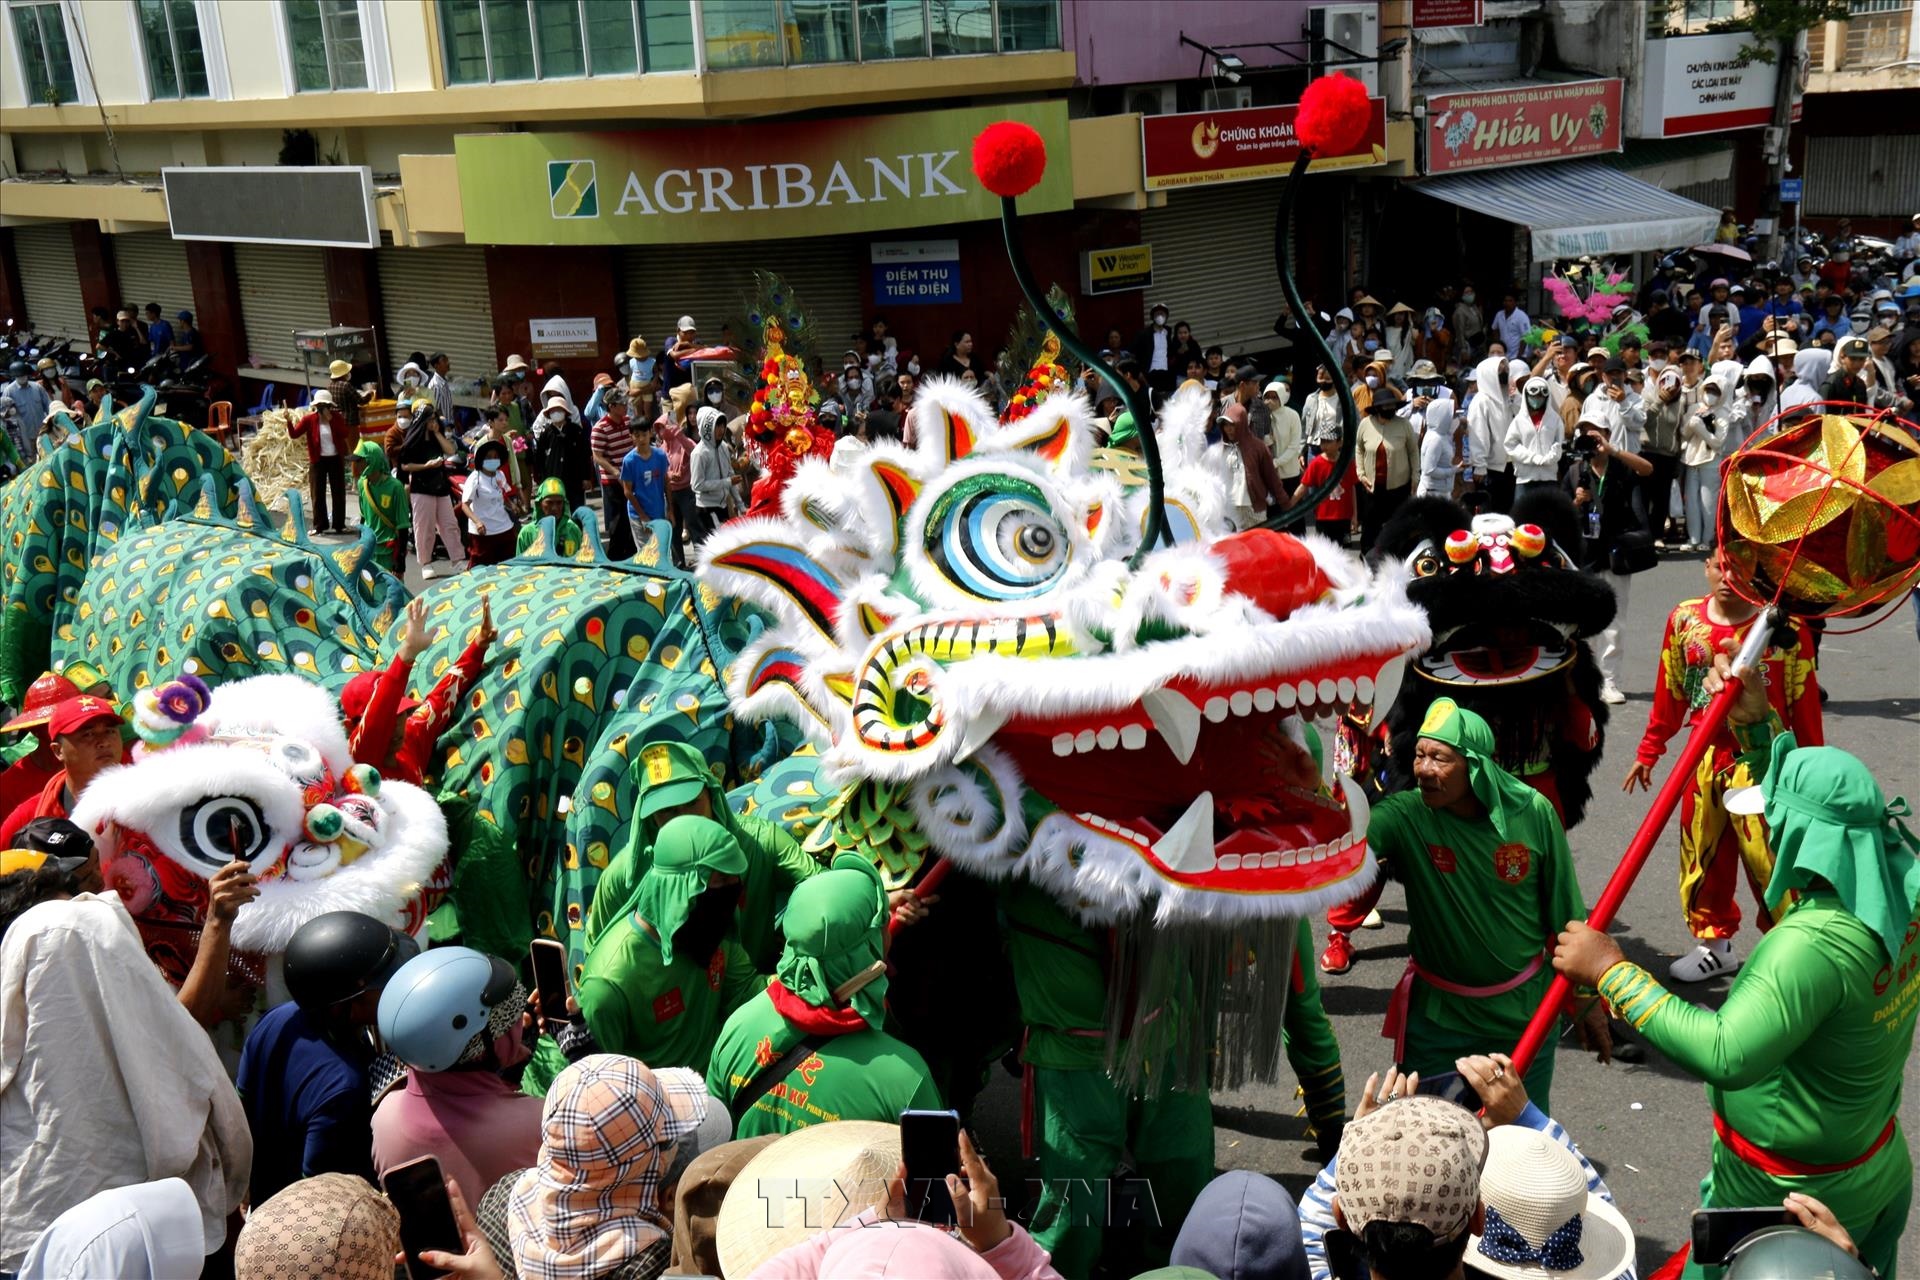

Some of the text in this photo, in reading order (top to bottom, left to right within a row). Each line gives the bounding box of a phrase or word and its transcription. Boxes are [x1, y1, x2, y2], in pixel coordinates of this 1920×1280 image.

[1492, 95, 1507, 105] HOA
[1220, 122, 1293, 143] CHỨNG KHOÁN
[1473, 107, 1584, 151] Hiếu Vy
[613, 149, 967, 216] AGRIBANK
[886, 266, 949, 281] ĐIỂM THU
[919, 281, 950, 296] ĐIỆN
